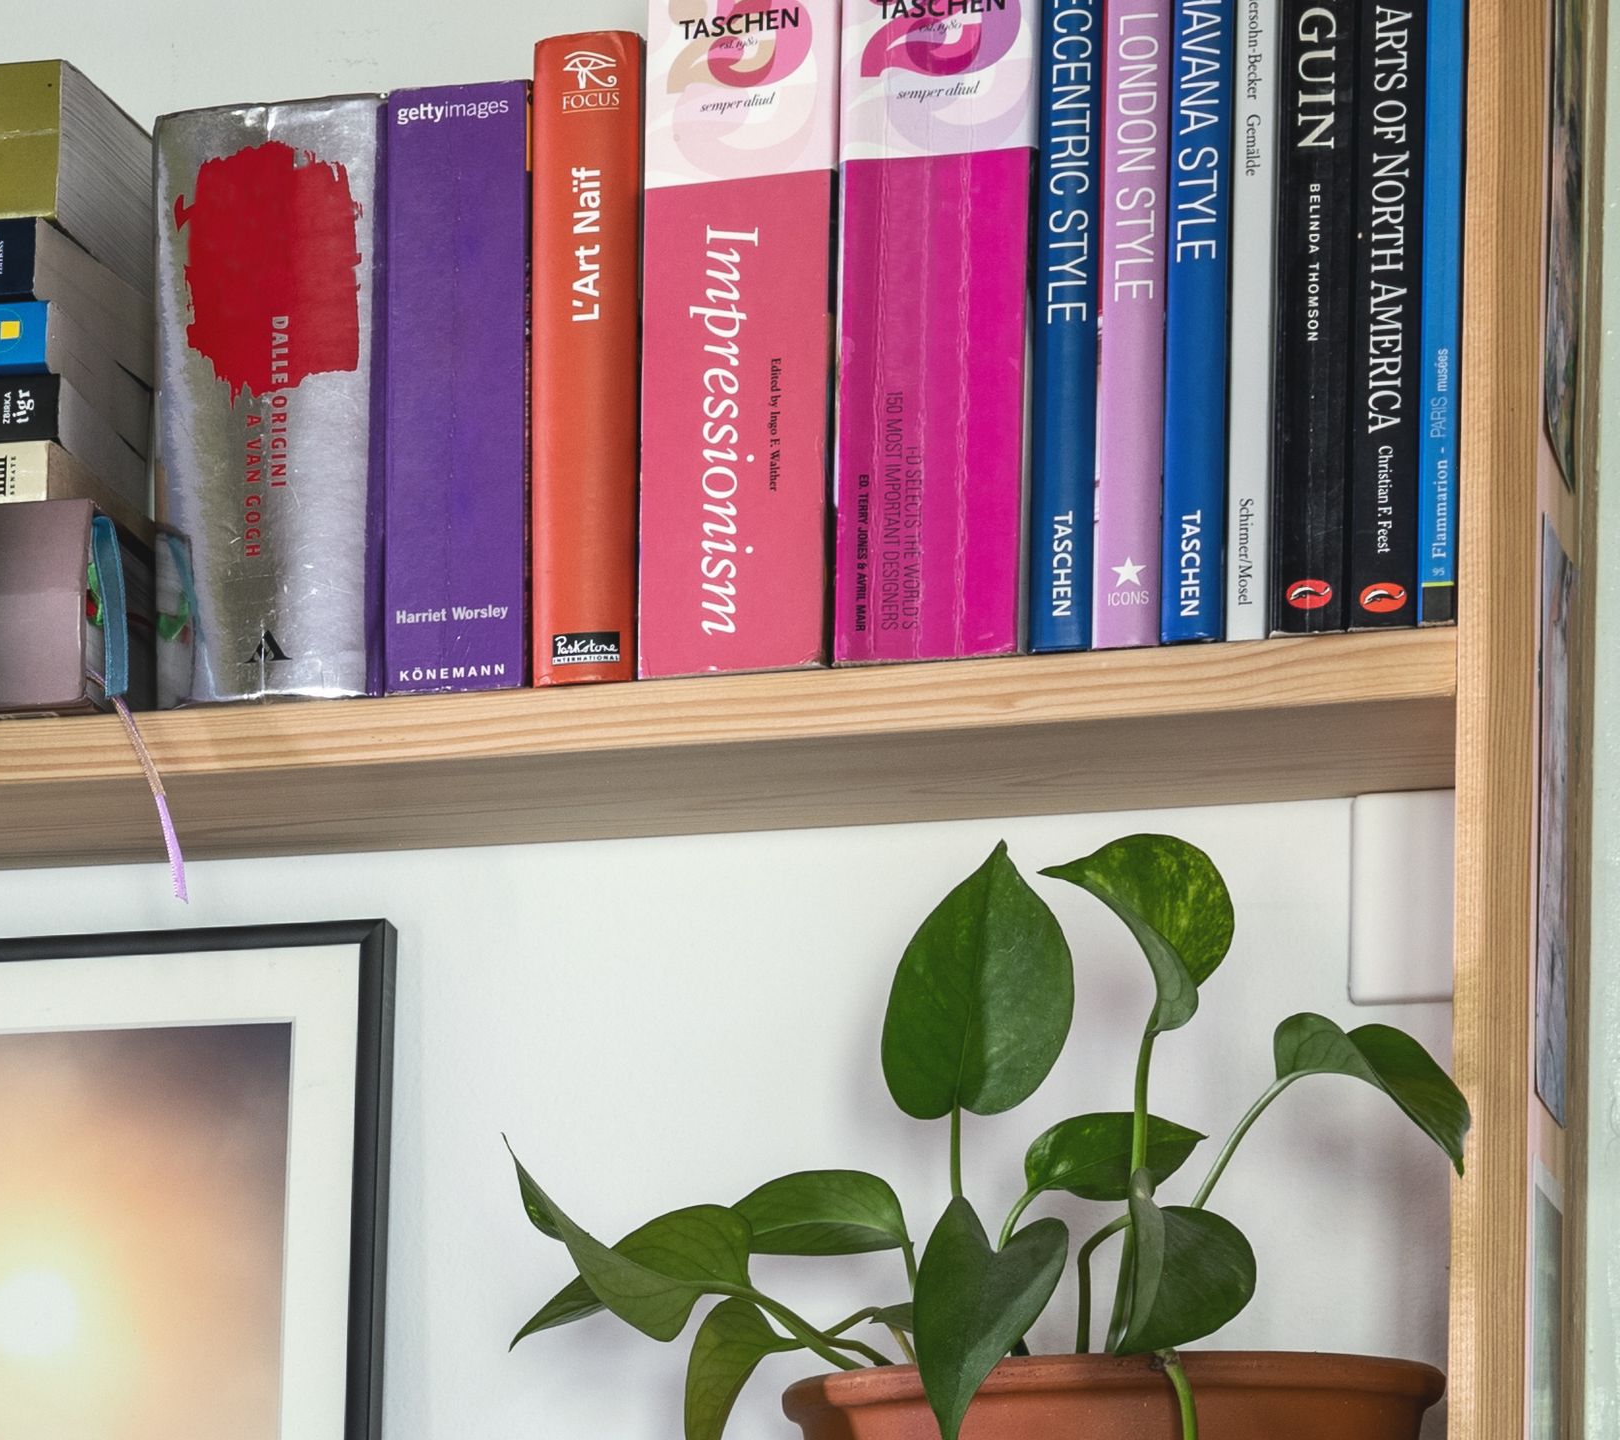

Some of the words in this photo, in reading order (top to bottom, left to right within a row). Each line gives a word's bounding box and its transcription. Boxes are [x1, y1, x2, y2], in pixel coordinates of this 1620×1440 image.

[1117, 13, 1158, 175] LONDON
[1374, 5, 1411, 92] ARTS
[397, 98, 509, 124] gettyimages
[1373, 100, 1410, 141] OF
[1114, 186, 1154, 302] STYLE
[1370, 149, 1410, 272] NORTH
[1367, 280, 1410, 433] AMERICA
[701, 224, 759, 634] Impressionism
